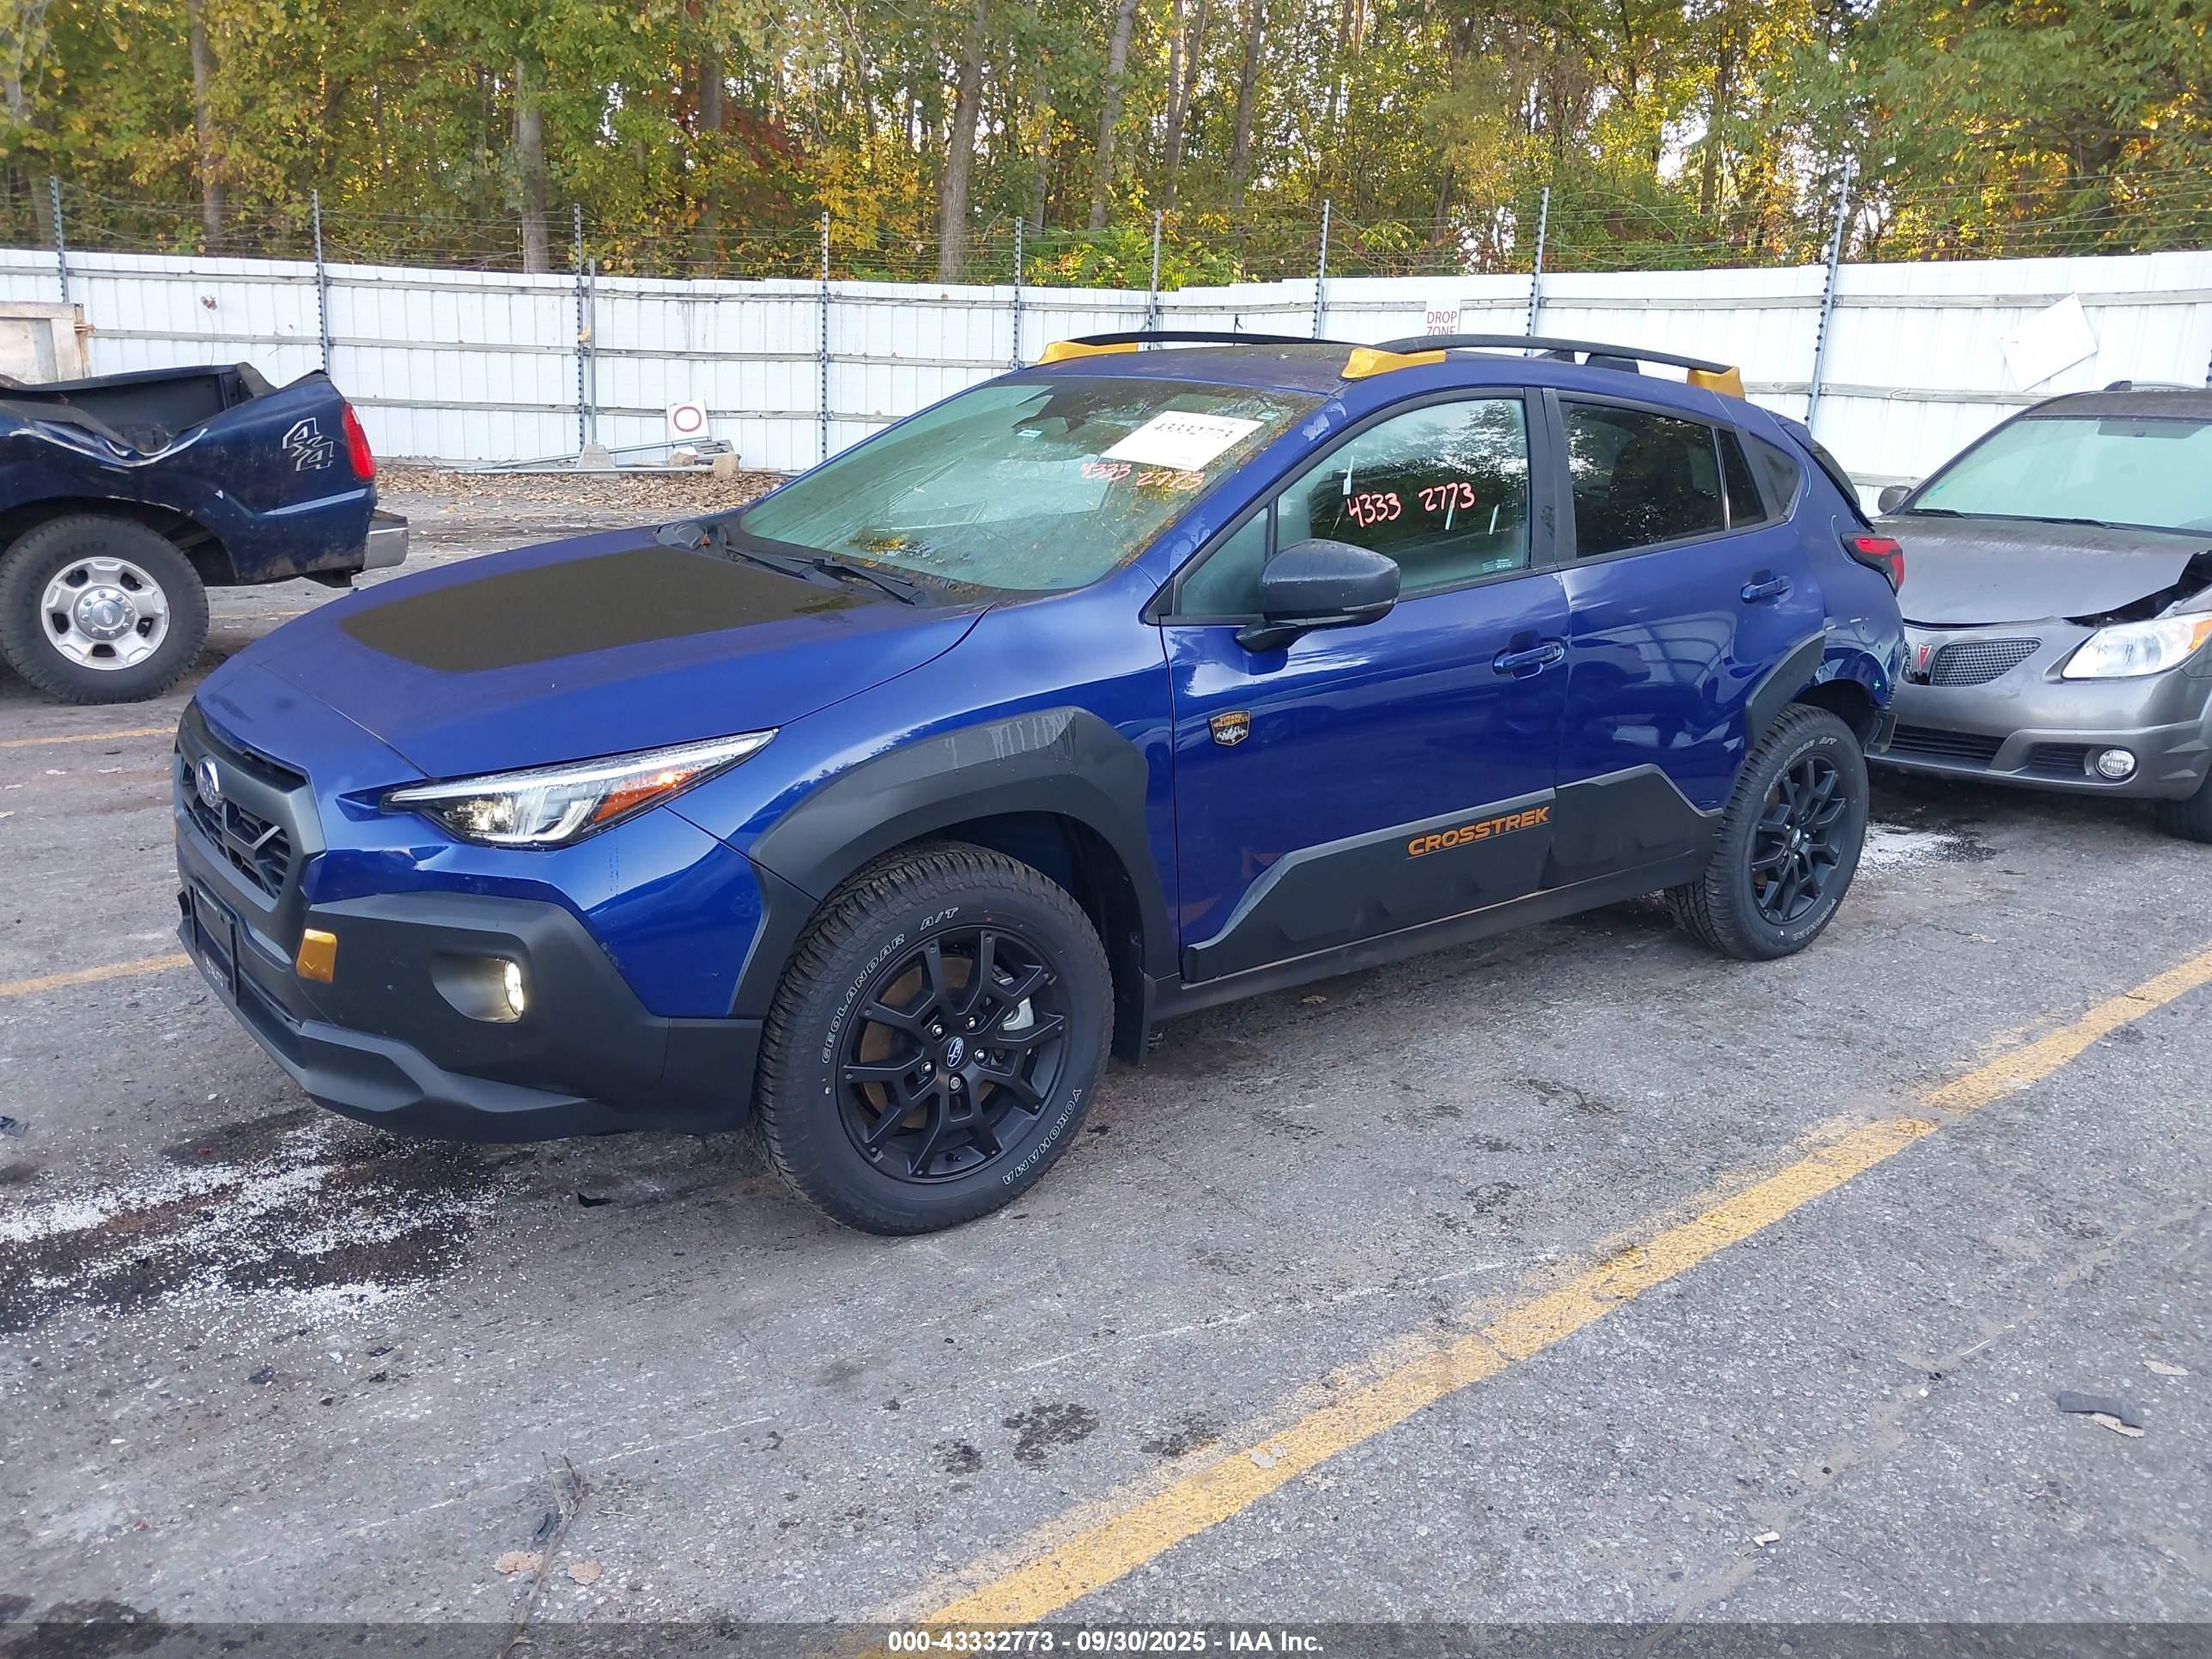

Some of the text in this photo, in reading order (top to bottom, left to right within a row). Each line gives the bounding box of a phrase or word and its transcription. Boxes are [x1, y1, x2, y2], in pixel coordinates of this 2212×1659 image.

[1426, 310, 1457, 324] DROP
[1426, 325, 1456, 336] ZONE
[1079, 463, 1205, 490] 4333 2773
[1346, 482, 1475, 528] 4333 2773
[1407, 805, 1551, 856] CROSSTREK
[822, 906, 959, 1065] GEOLANDAR A/T
[1002, 1087, 1082, 1186] YOKOHAMA
